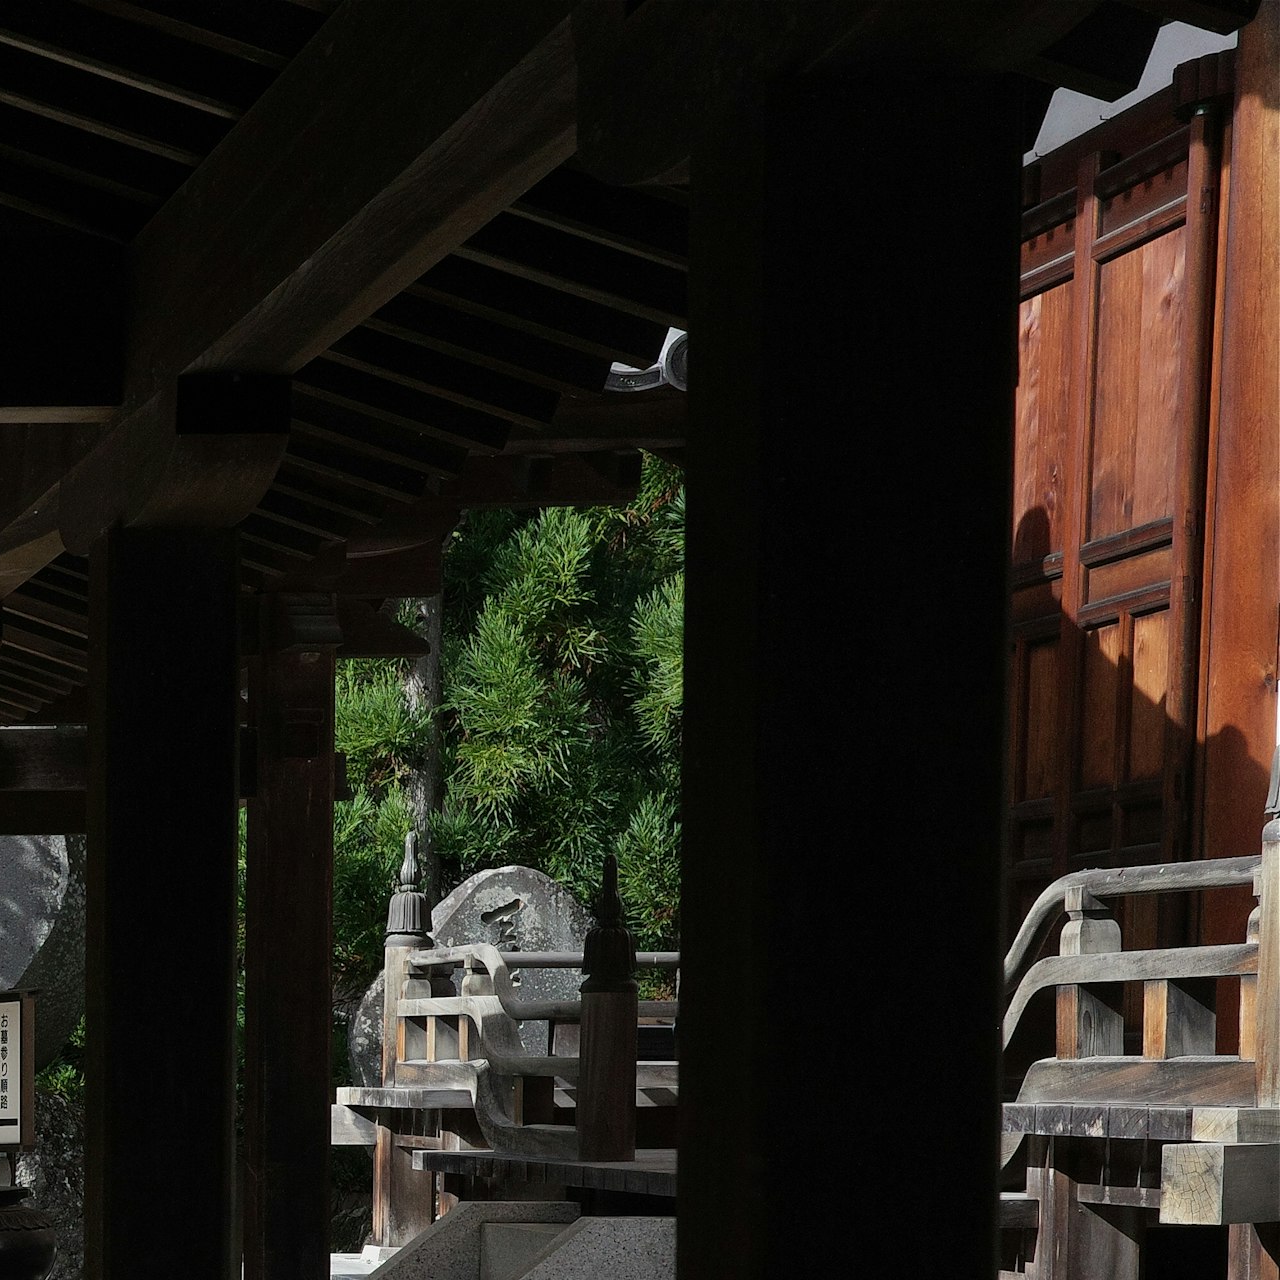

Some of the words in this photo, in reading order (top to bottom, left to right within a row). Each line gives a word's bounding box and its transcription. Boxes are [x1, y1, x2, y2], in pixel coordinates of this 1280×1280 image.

[0, 1013, 8, 1109] お墓参り順路
